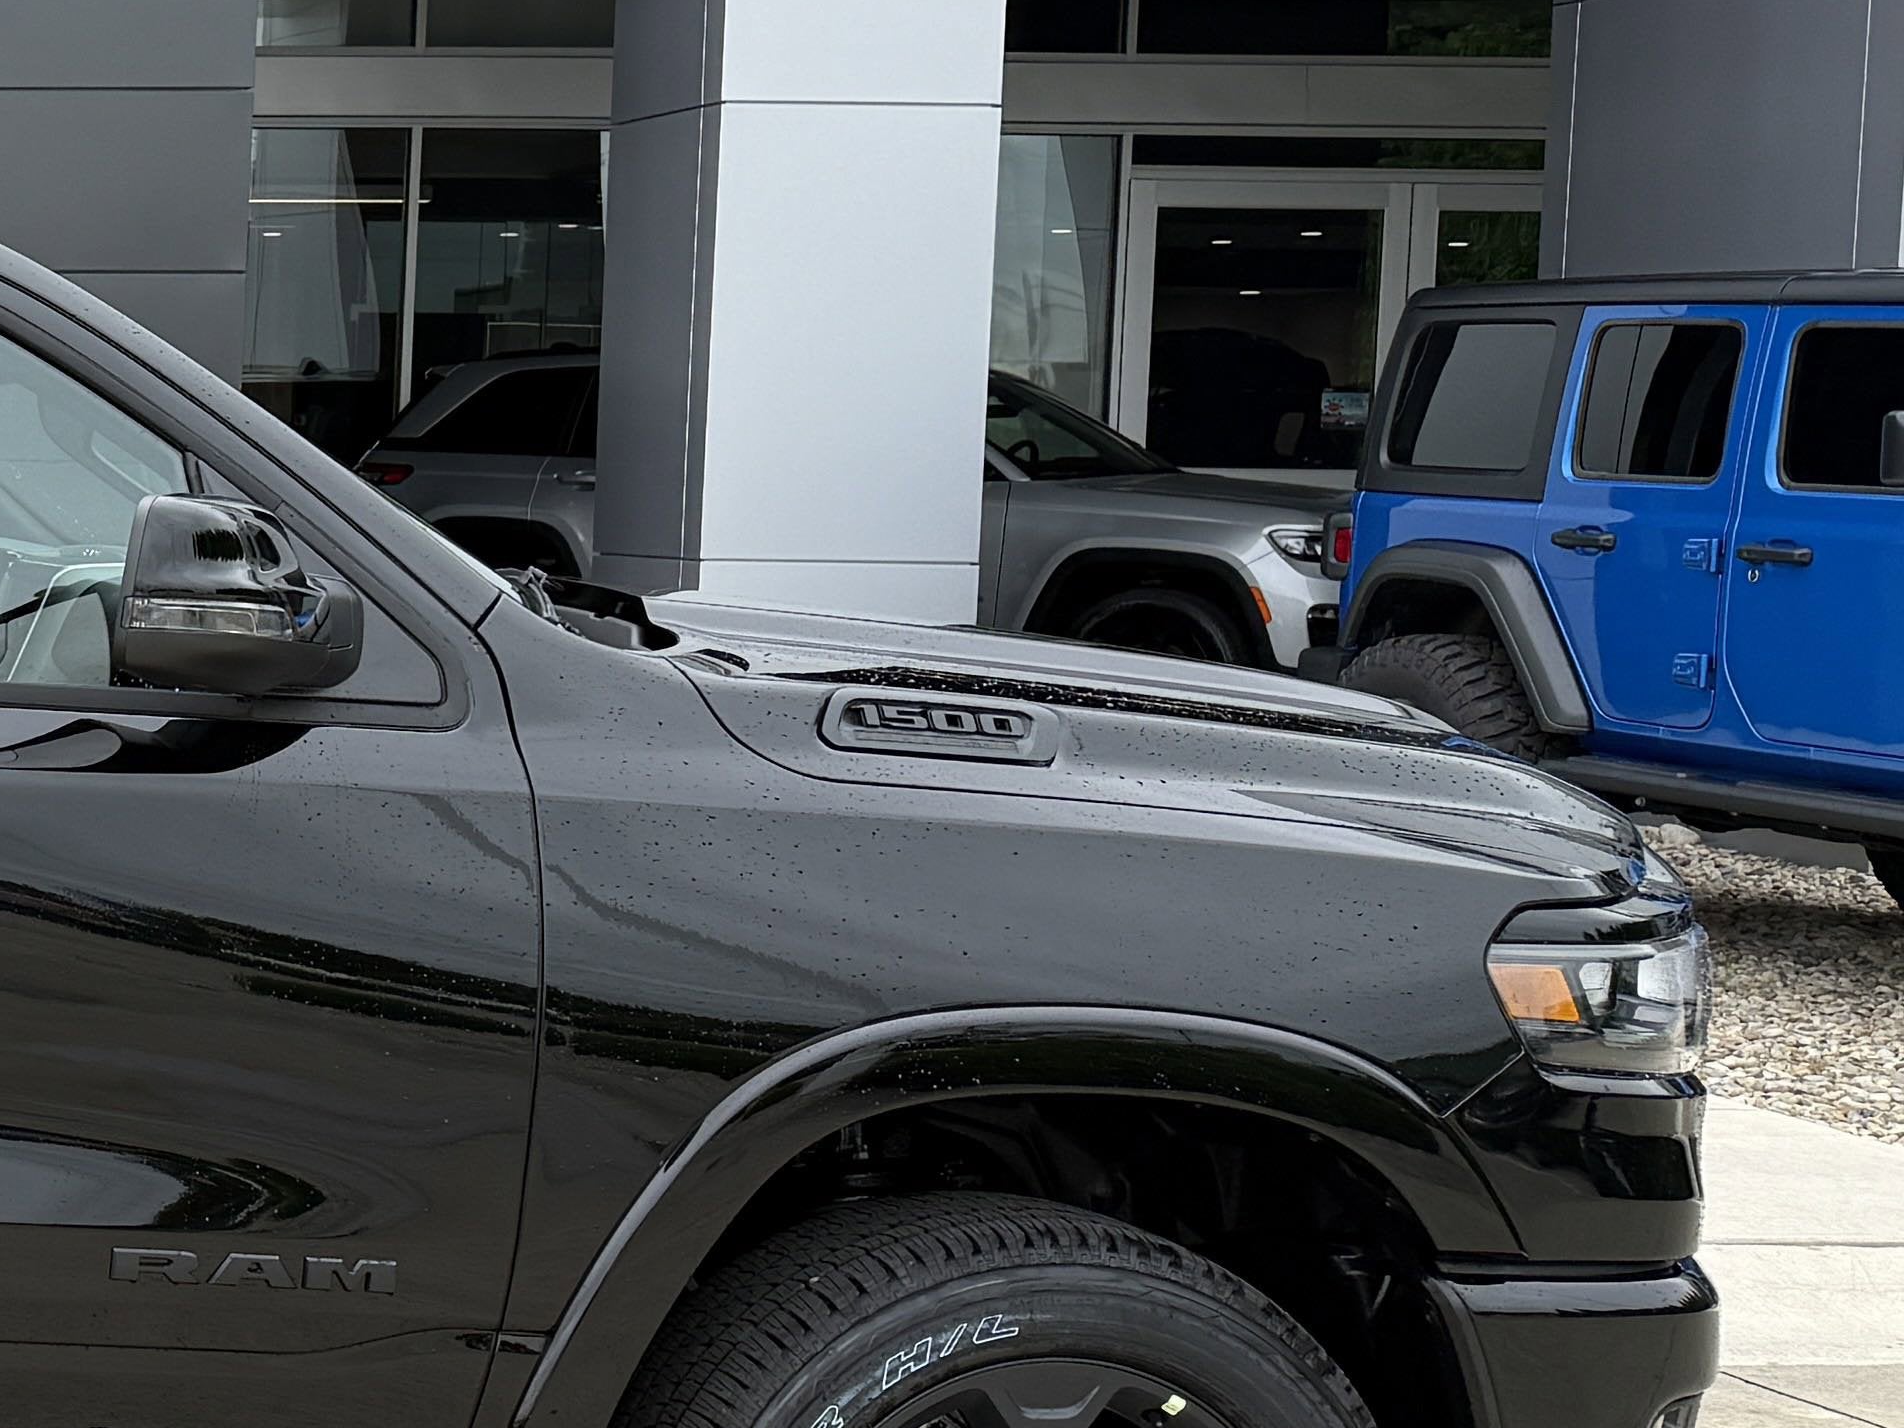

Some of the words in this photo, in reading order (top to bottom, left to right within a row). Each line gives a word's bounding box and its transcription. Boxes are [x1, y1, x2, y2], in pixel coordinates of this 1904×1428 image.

[856, 703, 1025, 738] 1500
[108, 1246, 398, 1296] RAM
[882, 1312, 1020, 1390] H/L
